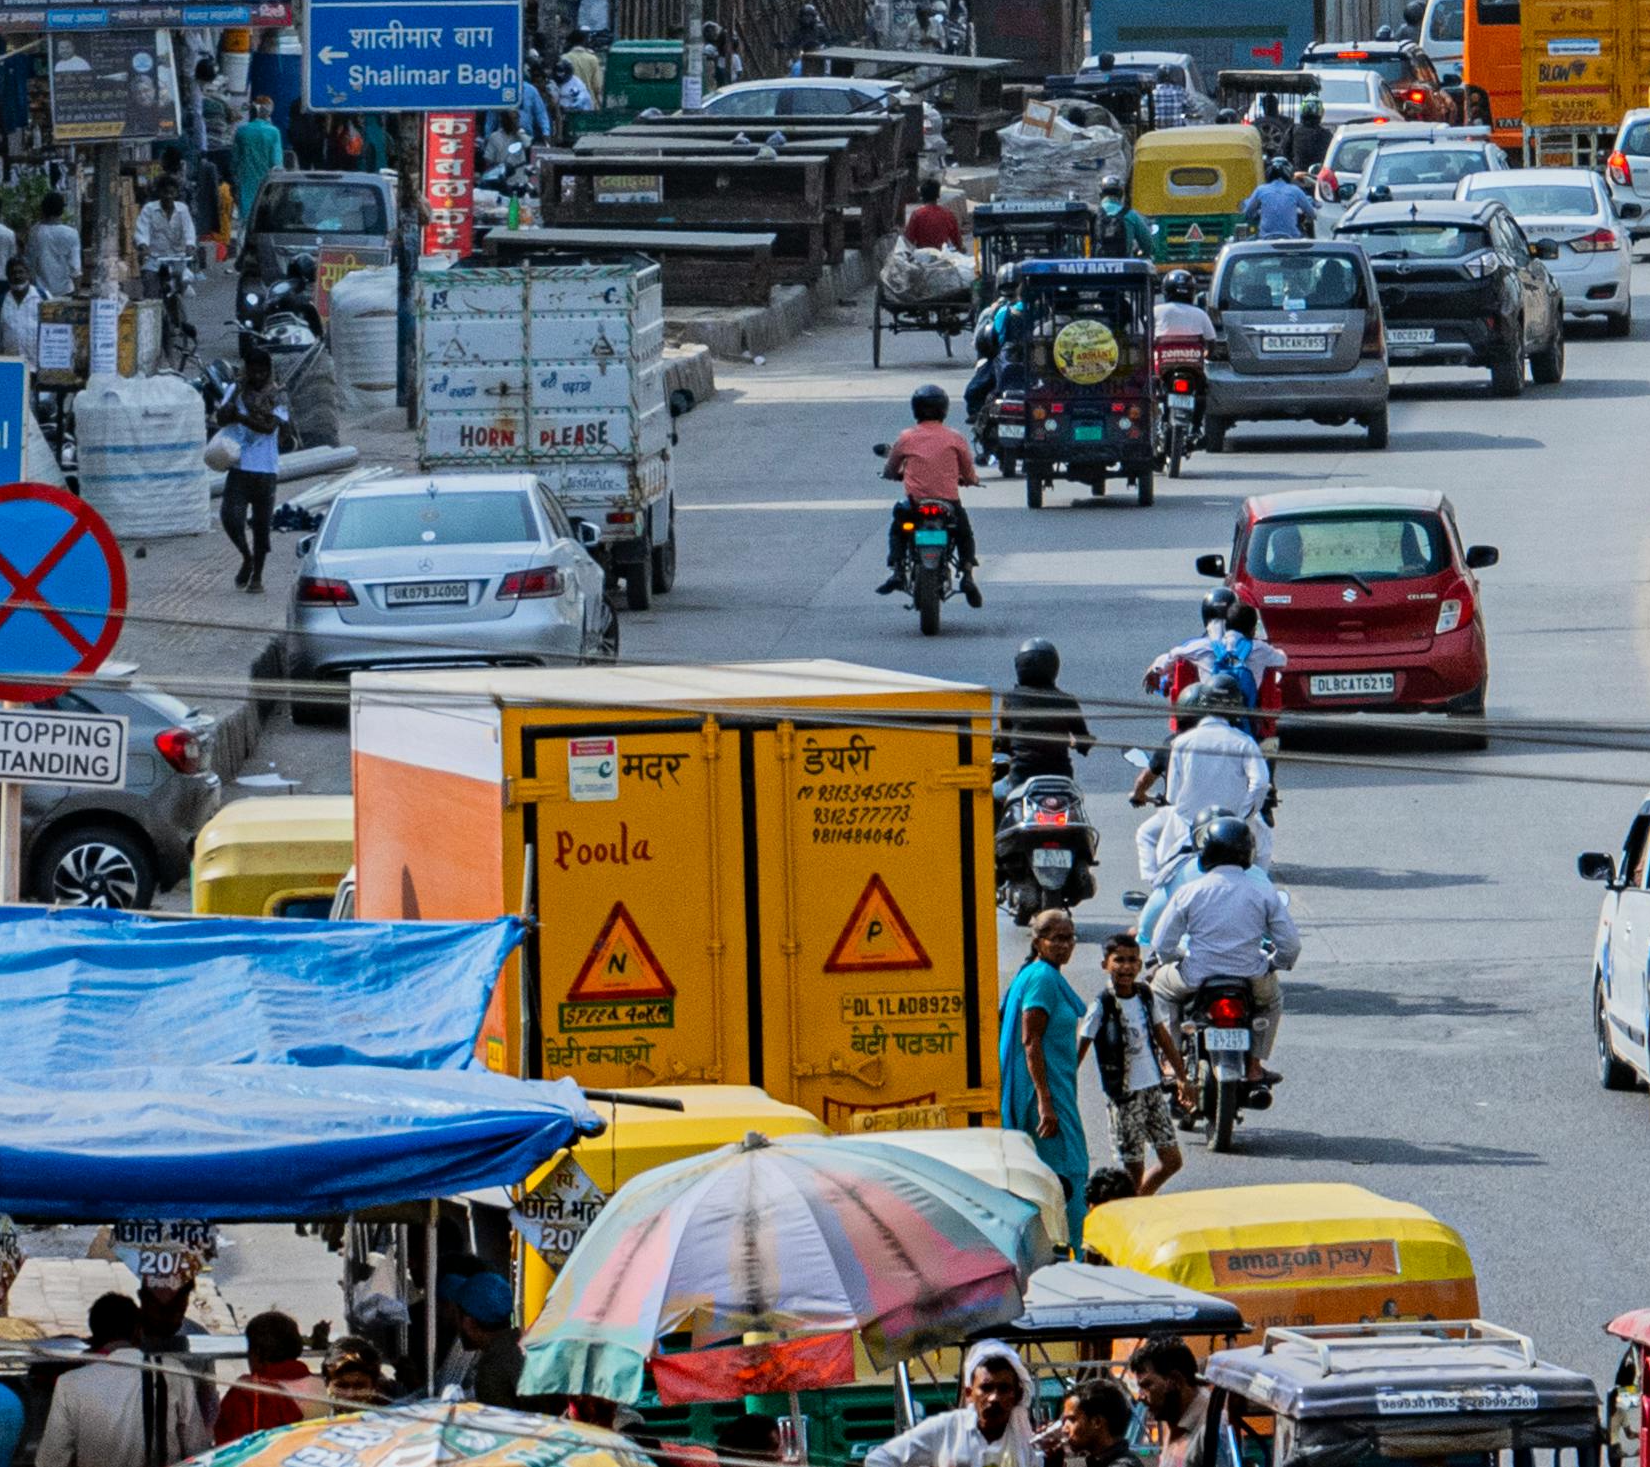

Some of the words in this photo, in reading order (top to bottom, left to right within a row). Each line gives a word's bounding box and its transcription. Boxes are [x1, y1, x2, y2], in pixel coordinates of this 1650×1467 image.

[349, 20, 442, 49] शालीमार
[454, 27, 493, 48] बाग
[348, 65, 450, 87] Shalimar
[457, 64, 516, 90] Bagh
[1161, 348, 1201, 359] zomato
[459, 425, 516, 448] HORN
[539, 420, 609, 447] PLEASE
[621, 750, 691, 788] मदर
[802, 733, 876, 777] डेयरी
[867, 920, 884, 943] P
[608, 953, 627, 974] N
[853, 993, 964, 1018] DL1LAD8929
[547, 1040, 582, 1068] बेटी
[851, 1023, 888, 1055] बेटी
[524, 1194, 564, 1221] छोले
[541, 1226, 583, 1252] 20/
[140, 1250, 189, 1274] 20/-
[1228, 1250, 1322, 1272] amazon
[1325, 1246, 1374, 1268] pay
